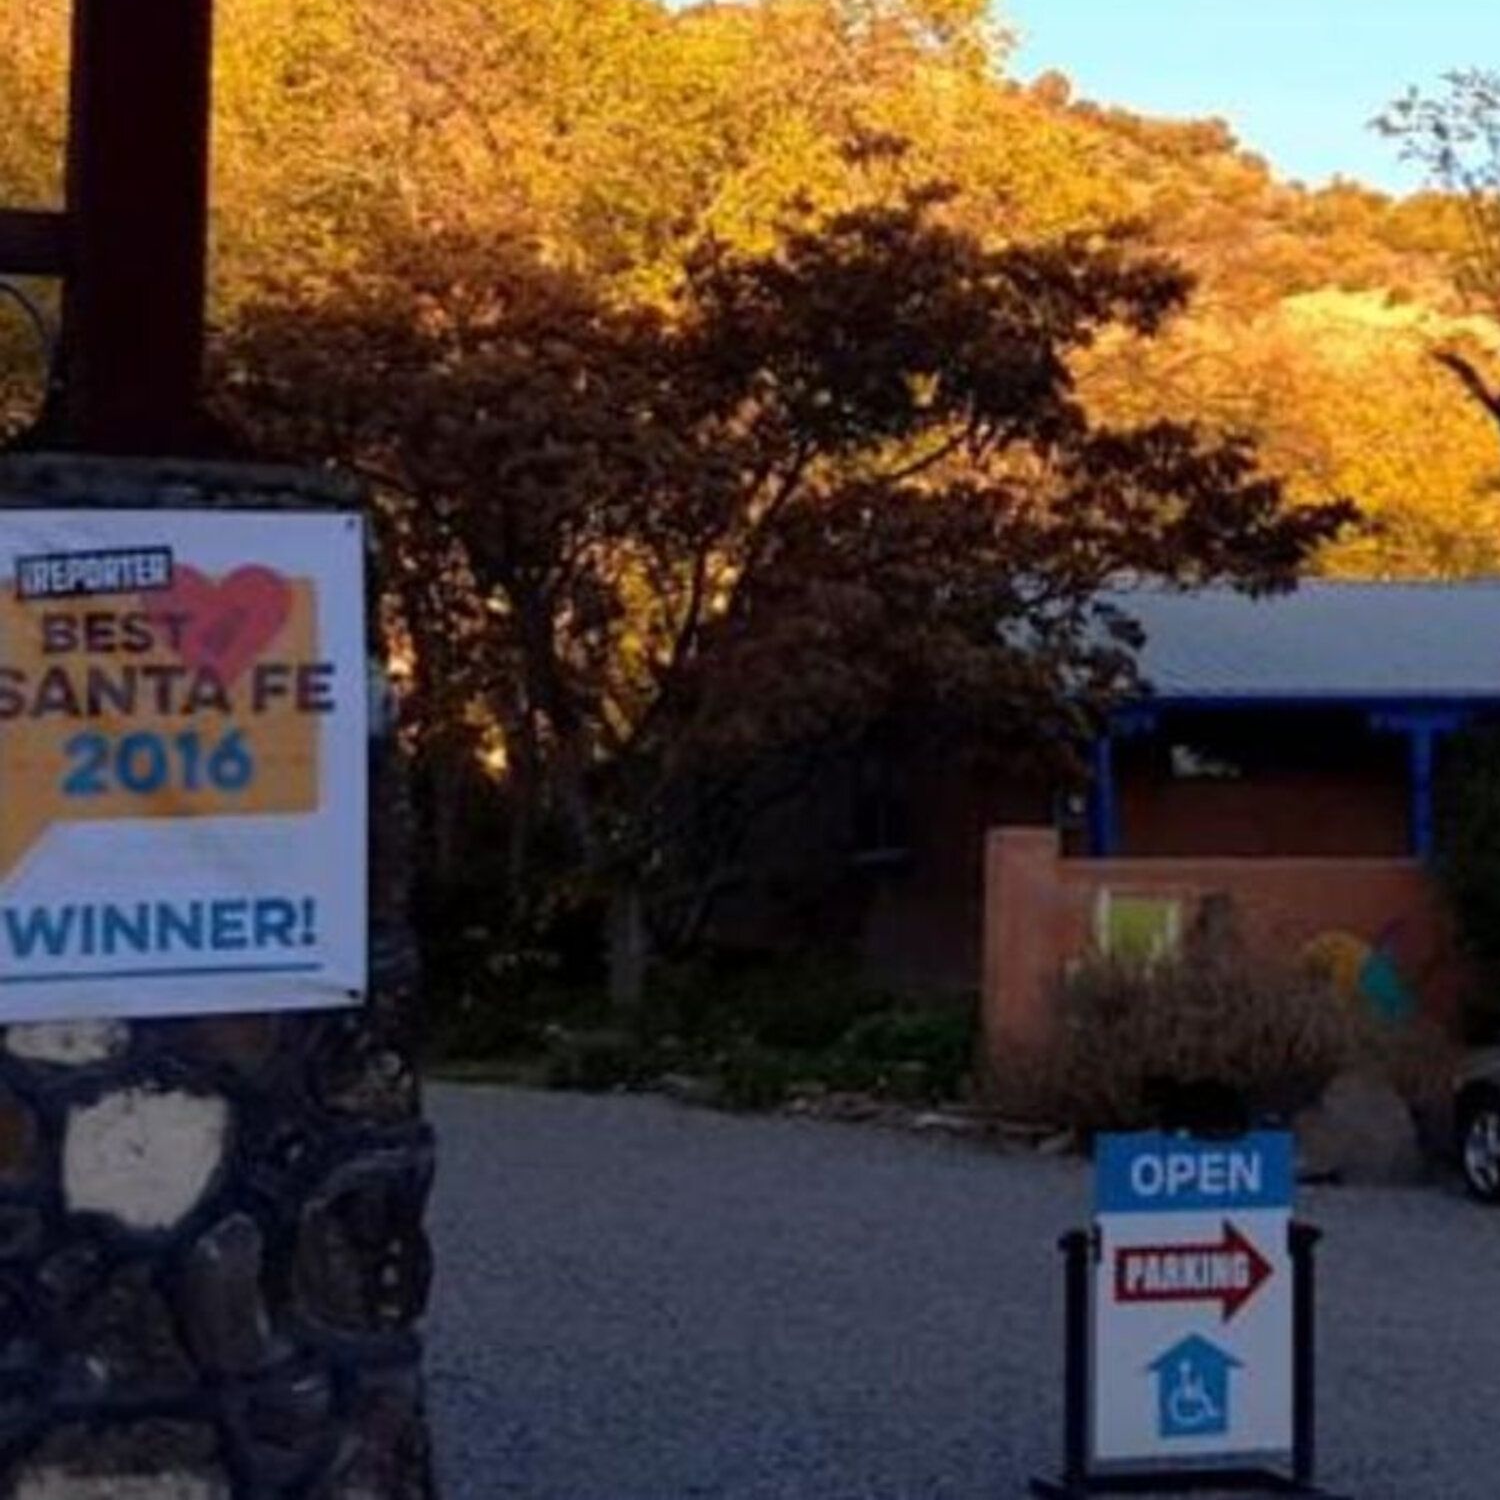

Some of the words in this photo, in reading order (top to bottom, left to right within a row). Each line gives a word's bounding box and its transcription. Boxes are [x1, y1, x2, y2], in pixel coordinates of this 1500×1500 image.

[32, 551, 167, 594] REPORTER
[42, 610, 192, 655] BEST
[0, 663, 231, 719] SANTA
[253, 663, 336, 714] FE
[62, 730, 252, 796] 2016
[2, 897, 317, 959] WINNER!
[1131, 1150, 1263, 1197] OPEN
[1124, 1250, 1250, 1294] PARKING
